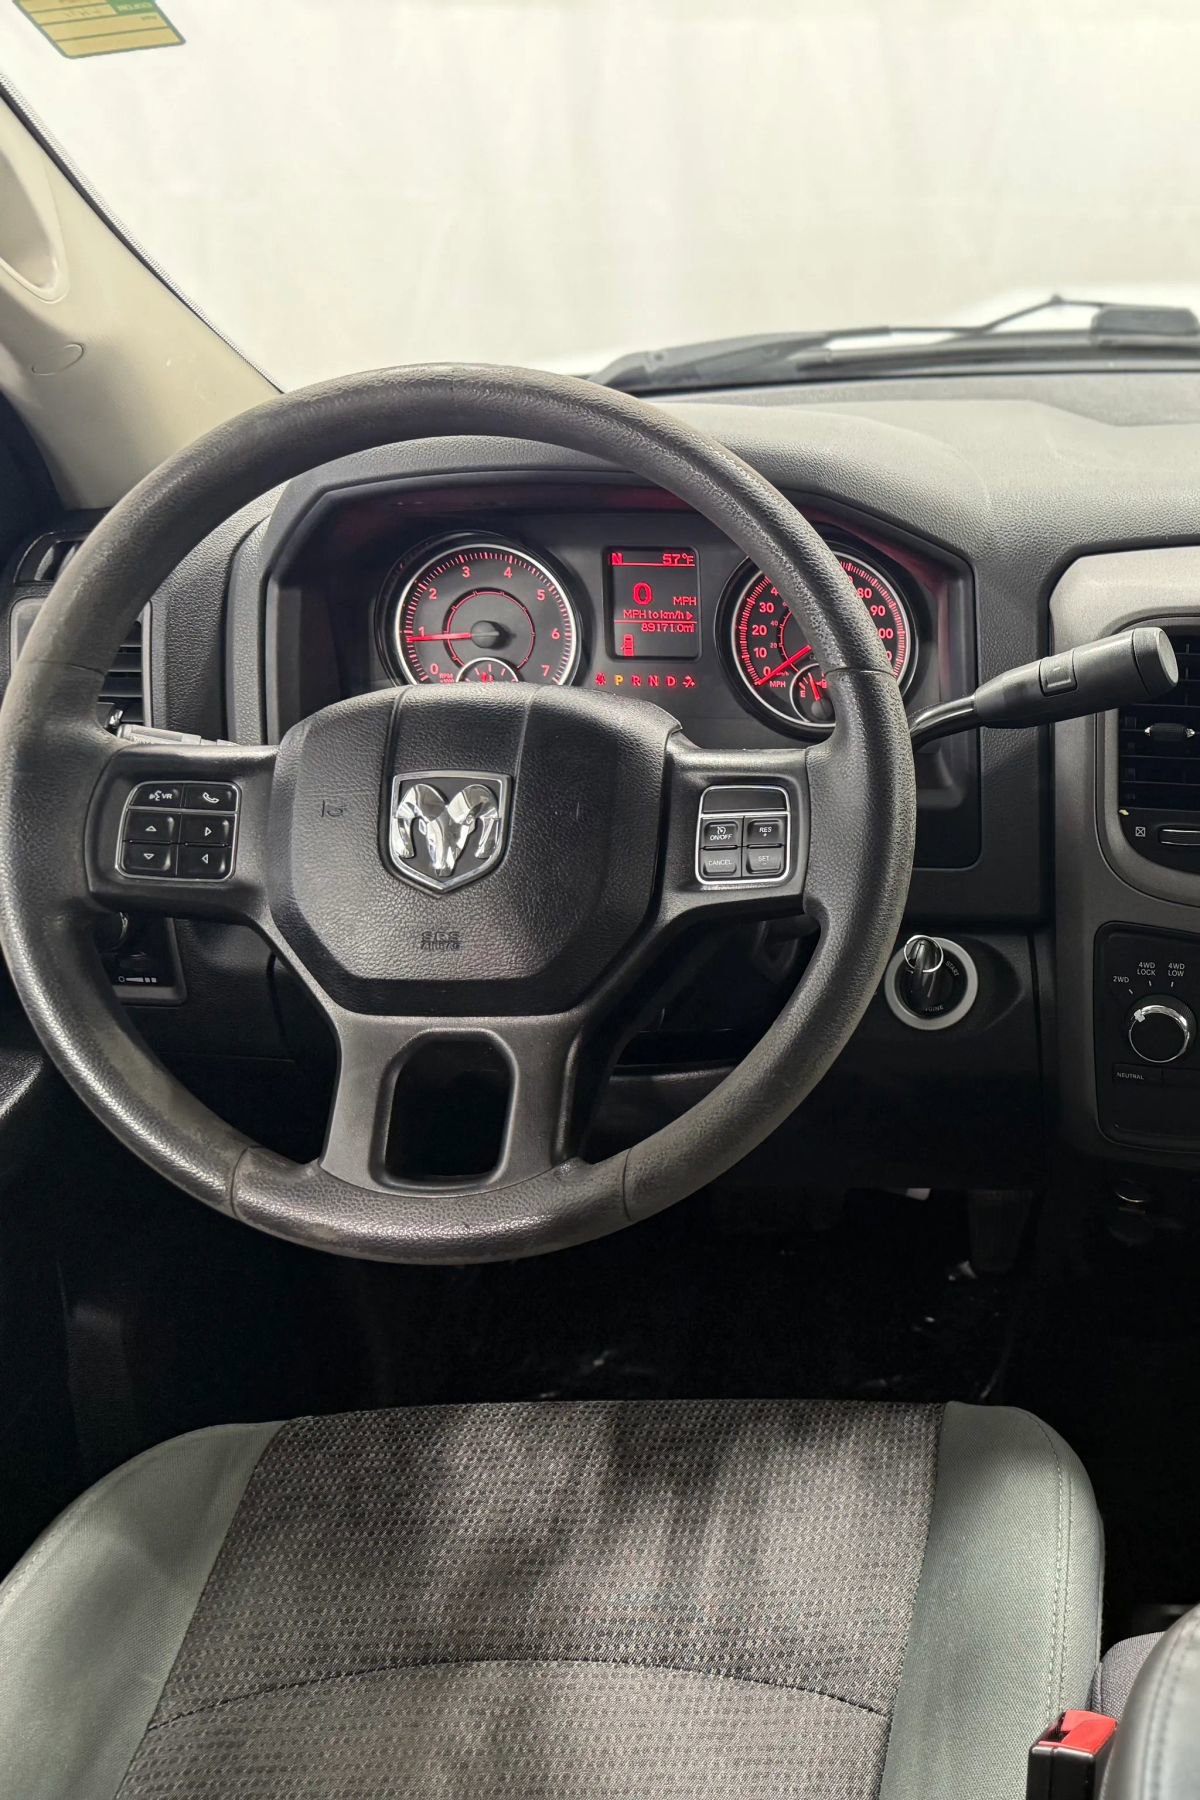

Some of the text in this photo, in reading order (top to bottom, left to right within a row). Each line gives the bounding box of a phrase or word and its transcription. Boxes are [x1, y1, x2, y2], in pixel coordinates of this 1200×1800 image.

[611, 552, 623, 565] N
[462, 566, 471, 578] 3
[503, 567, 512, 578] 4
[428, 588, 438, 600] 2
[537, 589, 546, 601] 5
[632, 582, 653, 606] 0
[672, 596, 697, 606] MPH
[759, 602, 775, 614] 30
[870, 605, 886, 617] 90
[623, 609, 685, 620] MPH to km/h
[418, 626, 426, 637] 1
[551, 628, 560, 640] 6
[752, 625, 768, 637] 20
[878, 628, 894, 640] 00
[754, 647, 768, 659] 10
[430, 663, 439, 675] 0
[541, 665, 551, 677] 7
[615, 674, 677, 686] P R N D
[769, 681, 786, 689] MPH
[945, 960, 960, 977] START
[1168, 962, 1186, 970] 4WD
[1137, 969, 1156, 977] LOCK
[1116, 1071, 1144, 1080] NEUTRAL
